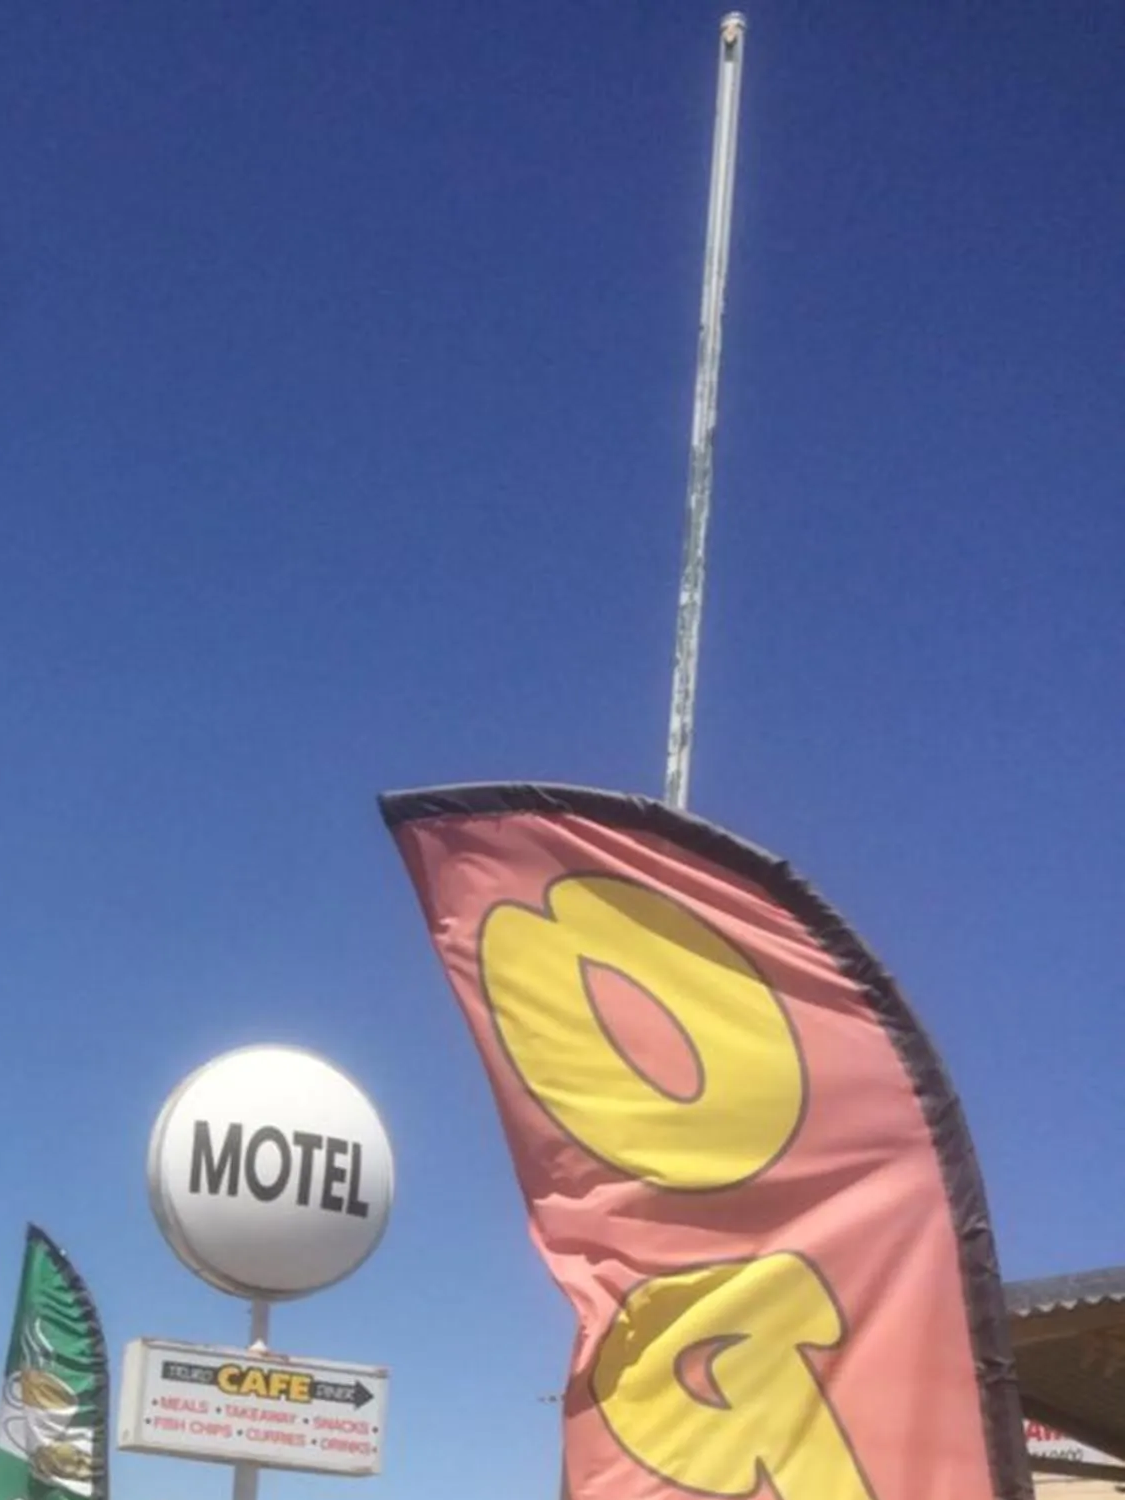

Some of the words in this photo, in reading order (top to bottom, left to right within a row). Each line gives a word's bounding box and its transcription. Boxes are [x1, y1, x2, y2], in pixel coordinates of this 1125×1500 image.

[189, 1119, 370, 1218] MOTEL
[216, 1362, 315, 1404] CAFE
[159, 1397, 209, 1414] MEALS
[224, 1403, 298, 1425] TAKEAWAY
[313, 1416, 370, 1436] SNACKS
[189, 1420, 232, 1438] CHIPS
